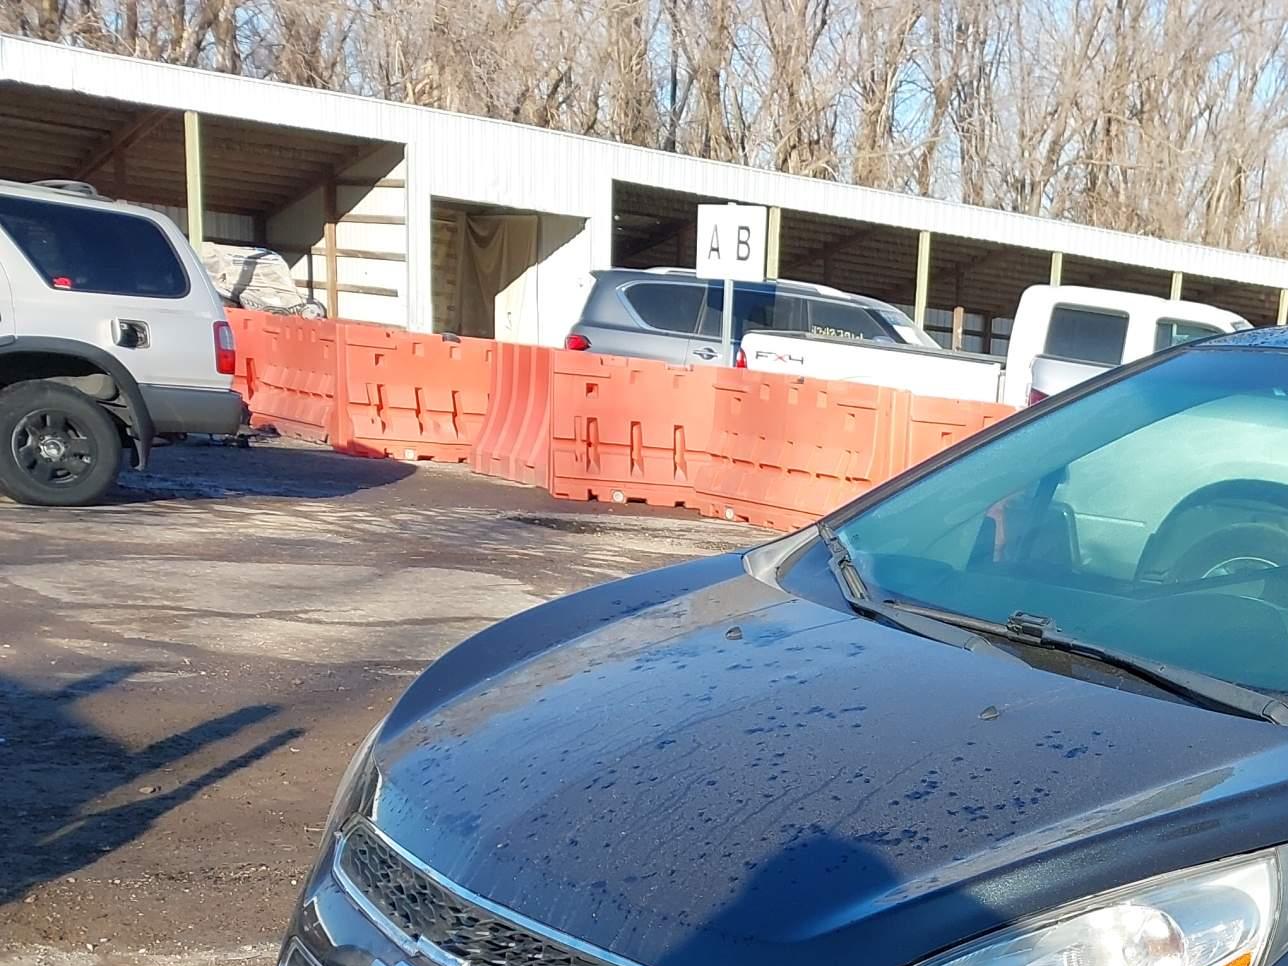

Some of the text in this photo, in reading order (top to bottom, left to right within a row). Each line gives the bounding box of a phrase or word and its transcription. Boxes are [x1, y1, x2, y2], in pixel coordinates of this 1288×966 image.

[708, 223, 751, 261] A B
[755, 350, 804, 366] FX4
